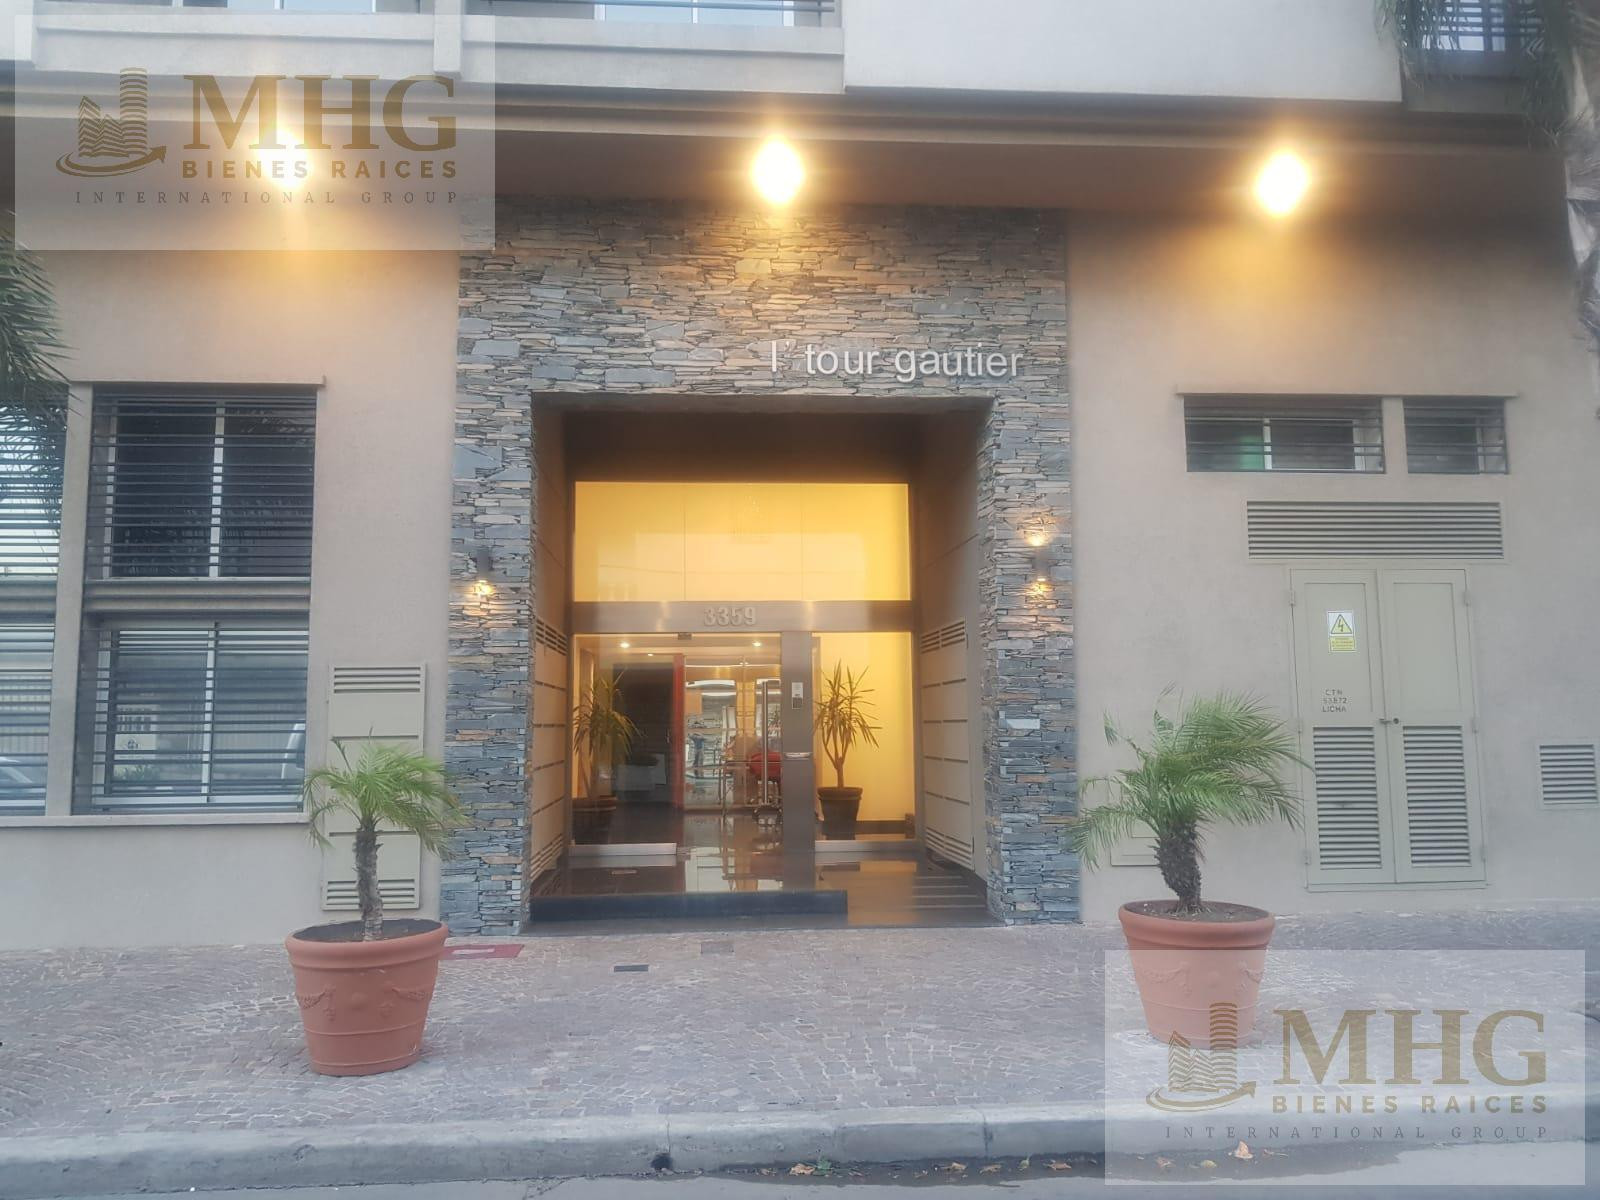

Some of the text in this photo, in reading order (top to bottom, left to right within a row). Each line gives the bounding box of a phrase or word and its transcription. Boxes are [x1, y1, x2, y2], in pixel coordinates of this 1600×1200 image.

[805, 344, 879, 375] tour
[895, 342, 1024, 383] gautier
[703, 606, 757, 626] 3359
